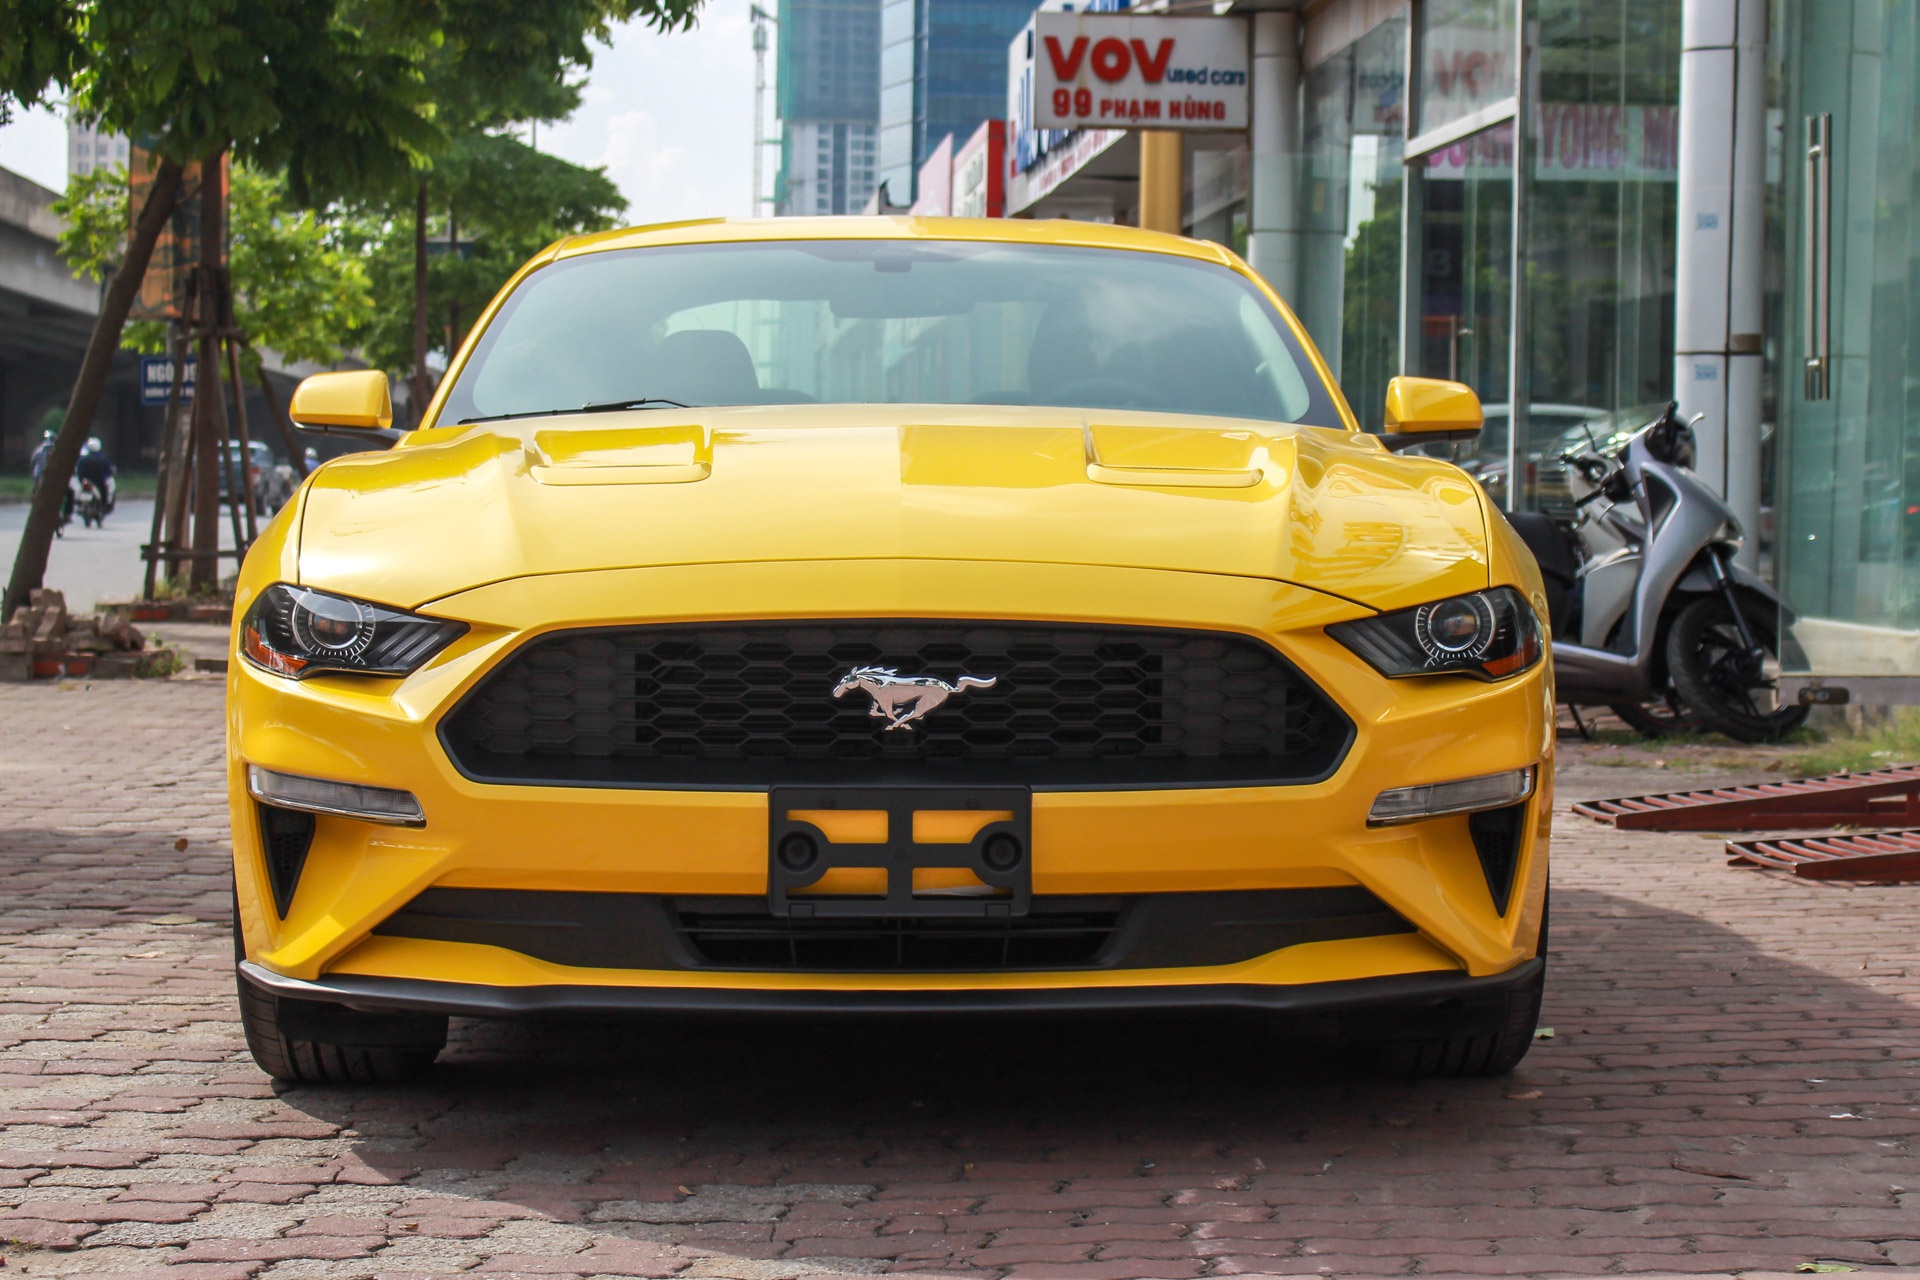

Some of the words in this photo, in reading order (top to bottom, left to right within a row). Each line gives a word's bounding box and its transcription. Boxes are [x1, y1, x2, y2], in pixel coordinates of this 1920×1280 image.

[1043, 35, 1176, 84] VOV
[1166, 67, 1208, 83] used
[1210, 69, 1246, 86] cars
[1053, 88, 1092, 117] 99
[1100, 98, 1161, 122] PHẠM
